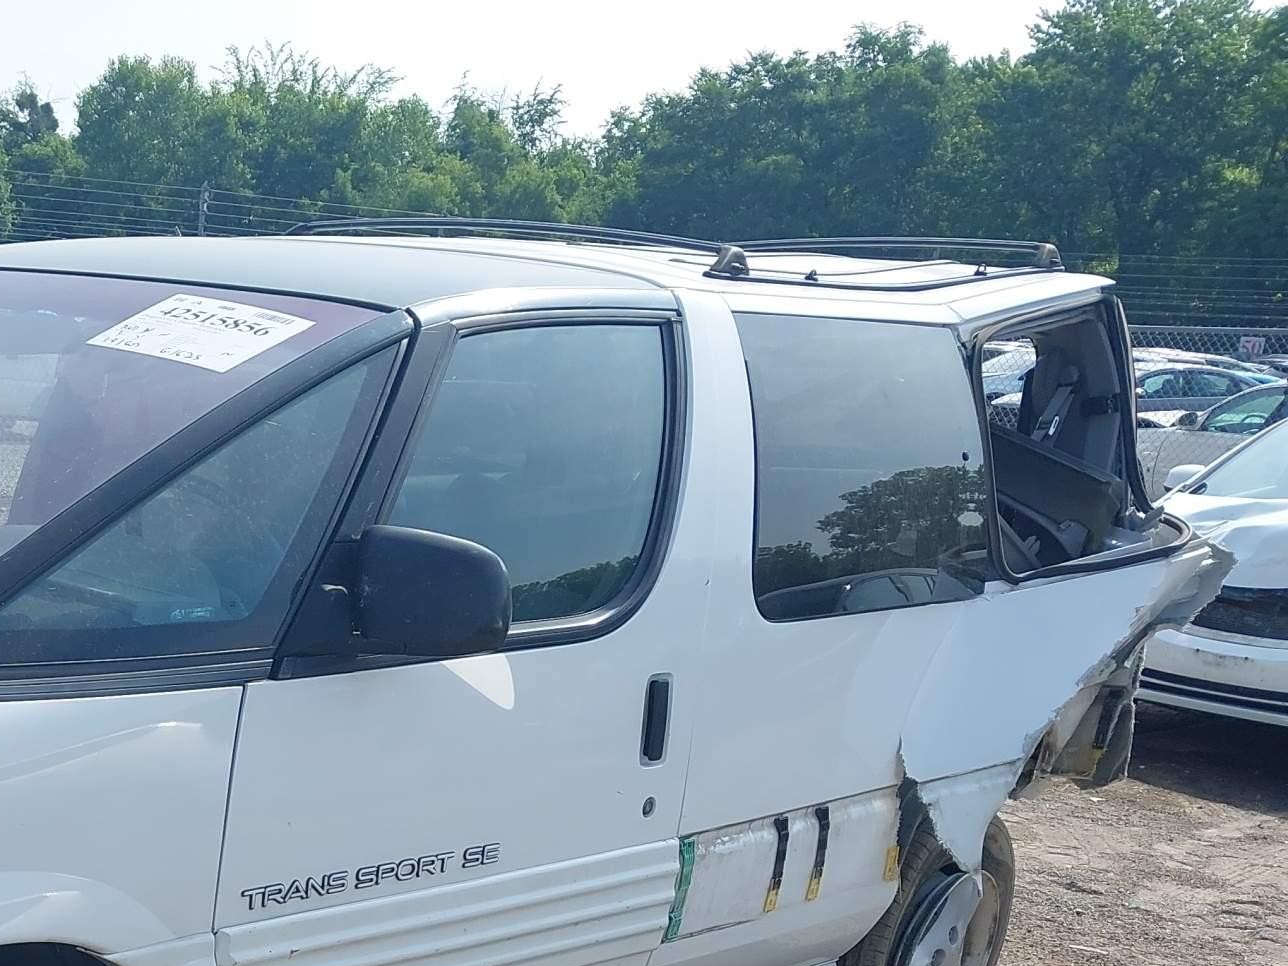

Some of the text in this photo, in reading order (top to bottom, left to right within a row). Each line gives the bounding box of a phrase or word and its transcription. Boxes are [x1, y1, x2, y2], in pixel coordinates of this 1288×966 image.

[160, 306, 275, 337] 42515856
[241, 843, 501, 910] TRANS SPORT SE
